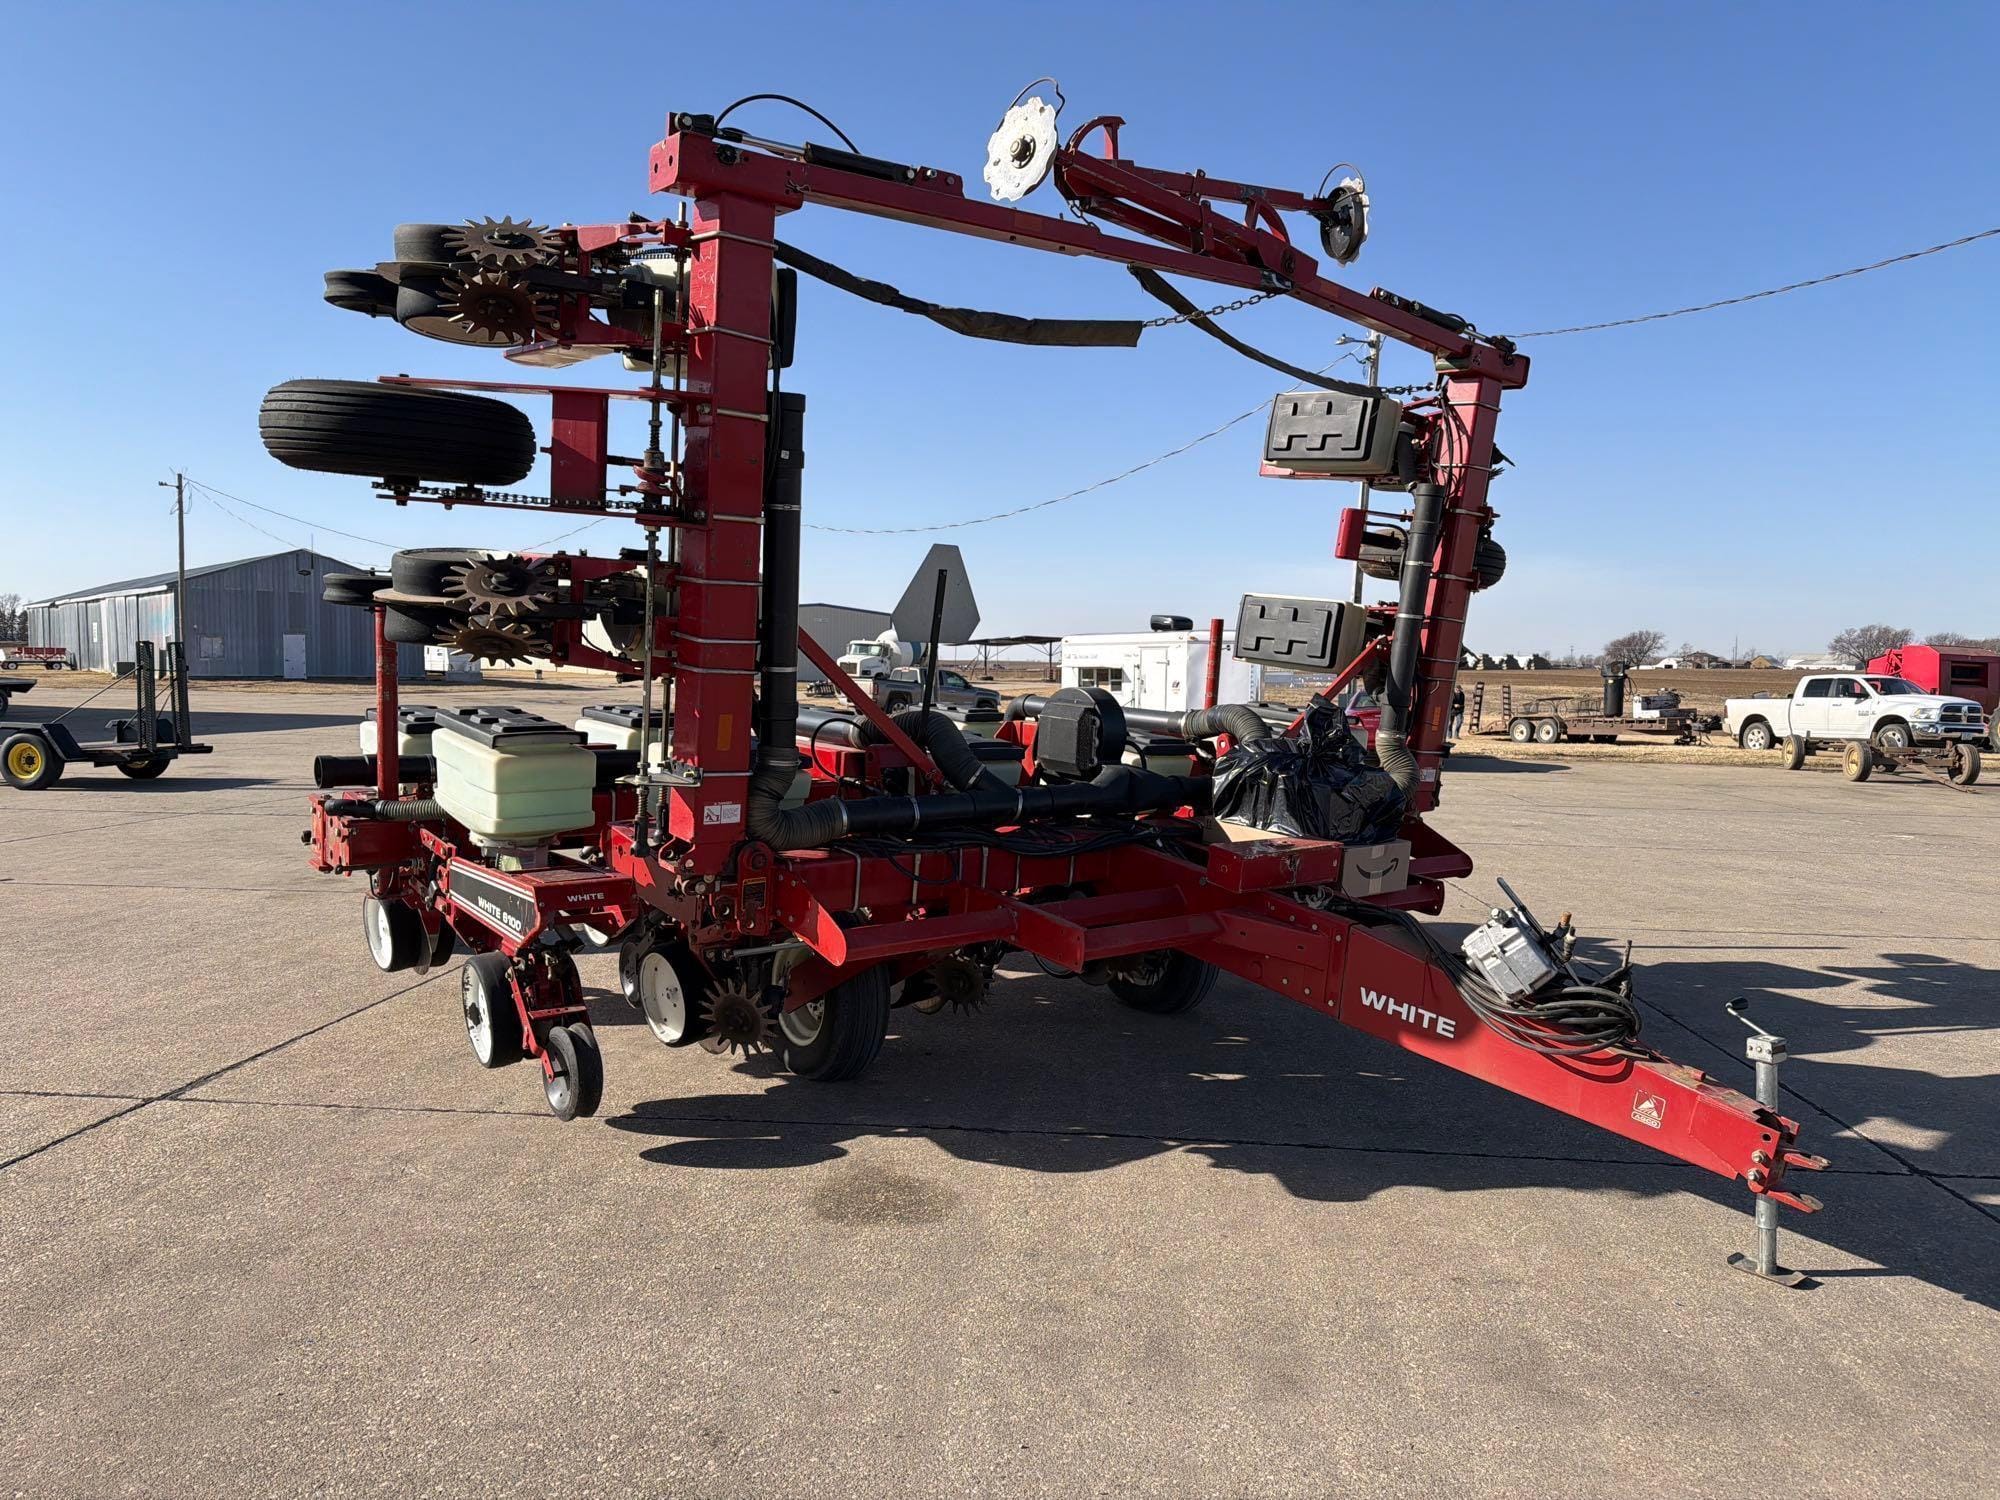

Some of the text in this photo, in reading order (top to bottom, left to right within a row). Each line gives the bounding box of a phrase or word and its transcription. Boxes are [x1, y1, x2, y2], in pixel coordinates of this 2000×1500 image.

[478, 896, 522, 931] WHITE 6100
[567, 892, 605, 902] WHITE
[1360, 987, 1456, 1038] WHITE
